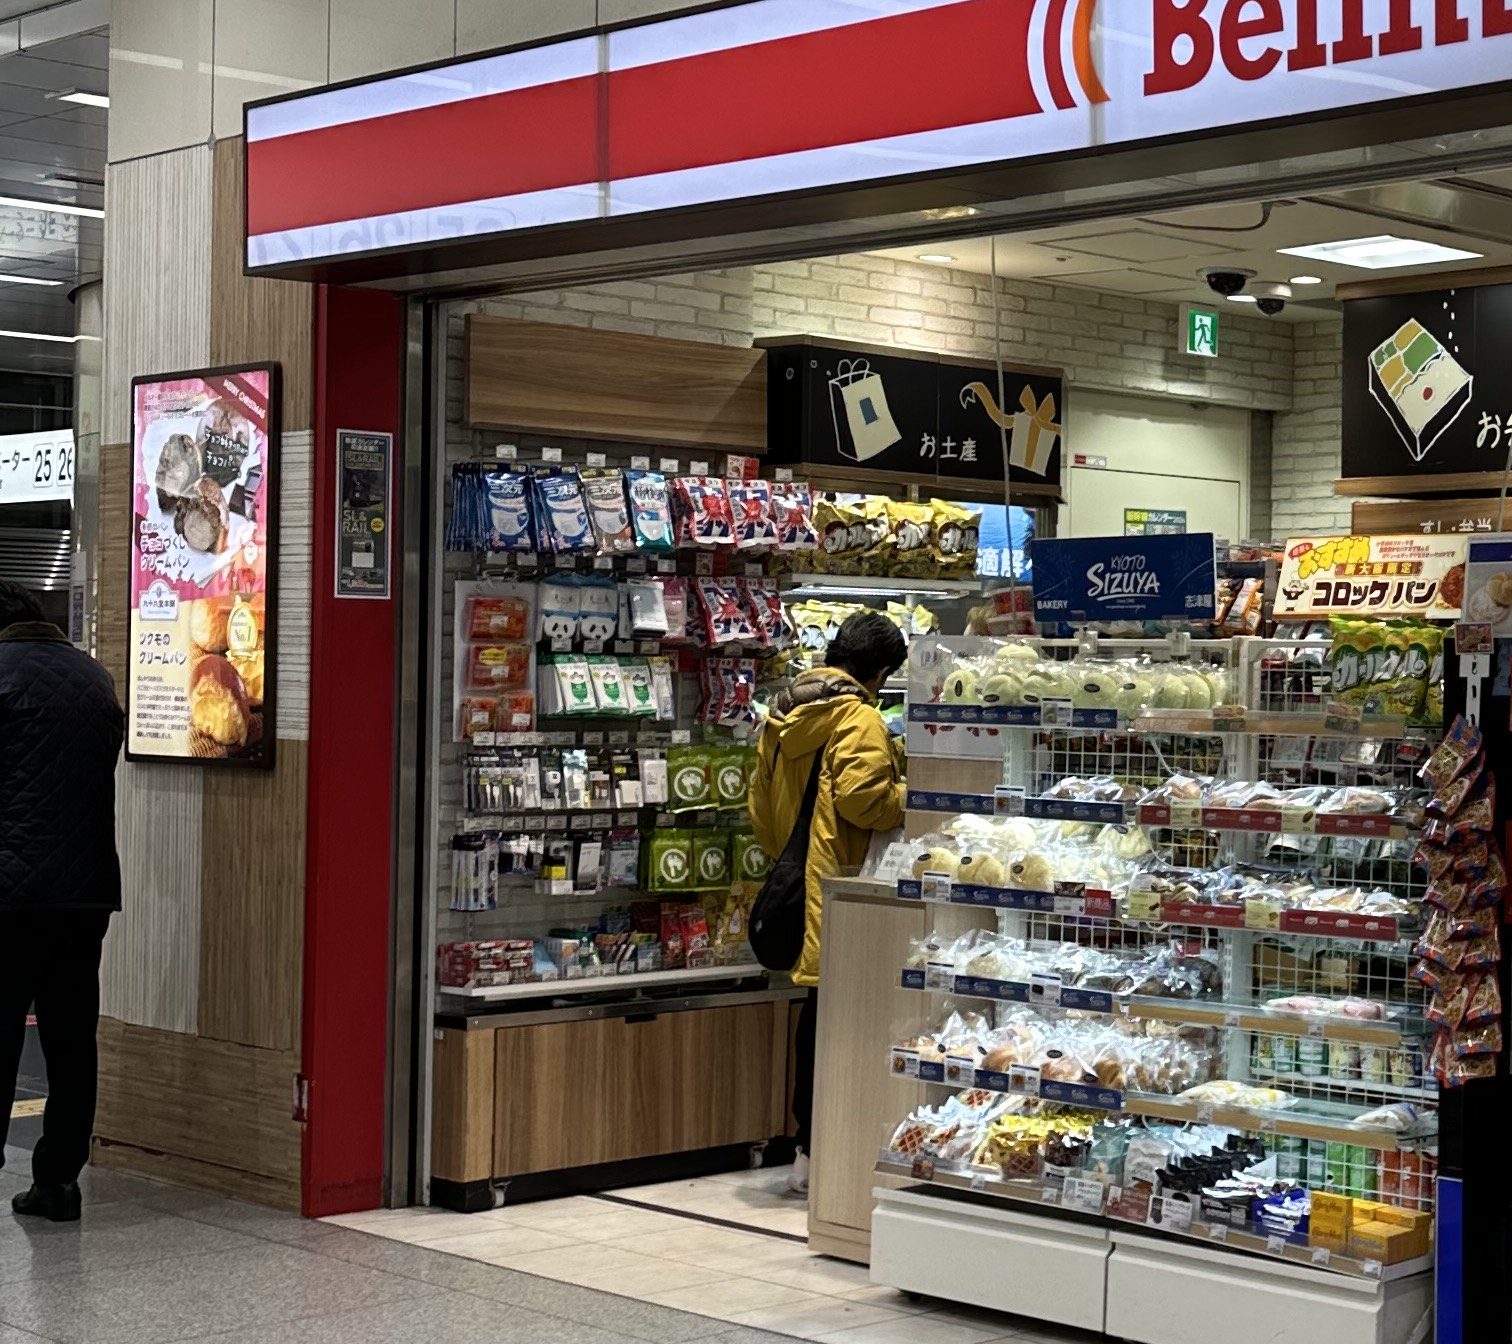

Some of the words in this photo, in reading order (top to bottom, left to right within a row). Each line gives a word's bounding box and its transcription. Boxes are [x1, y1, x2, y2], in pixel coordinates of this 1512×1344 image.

[919, 432, 979, 462] お土産
[35, 449, 52, 481] 25
[141, 536, 186, 551] チョコづくし
[141, 554, 191, 570] クリームパン
[1110, 555, 1146, 570] KYOTO
[1086, 562, 1160, 597] SIZUYA
[1312, 581, 1390, 607] コロッケ
[1392, 580, 1437, 604] パン
[1036, 600, 1068, 610] BAKERY
[138, 651, 188, 666] クリームパン
